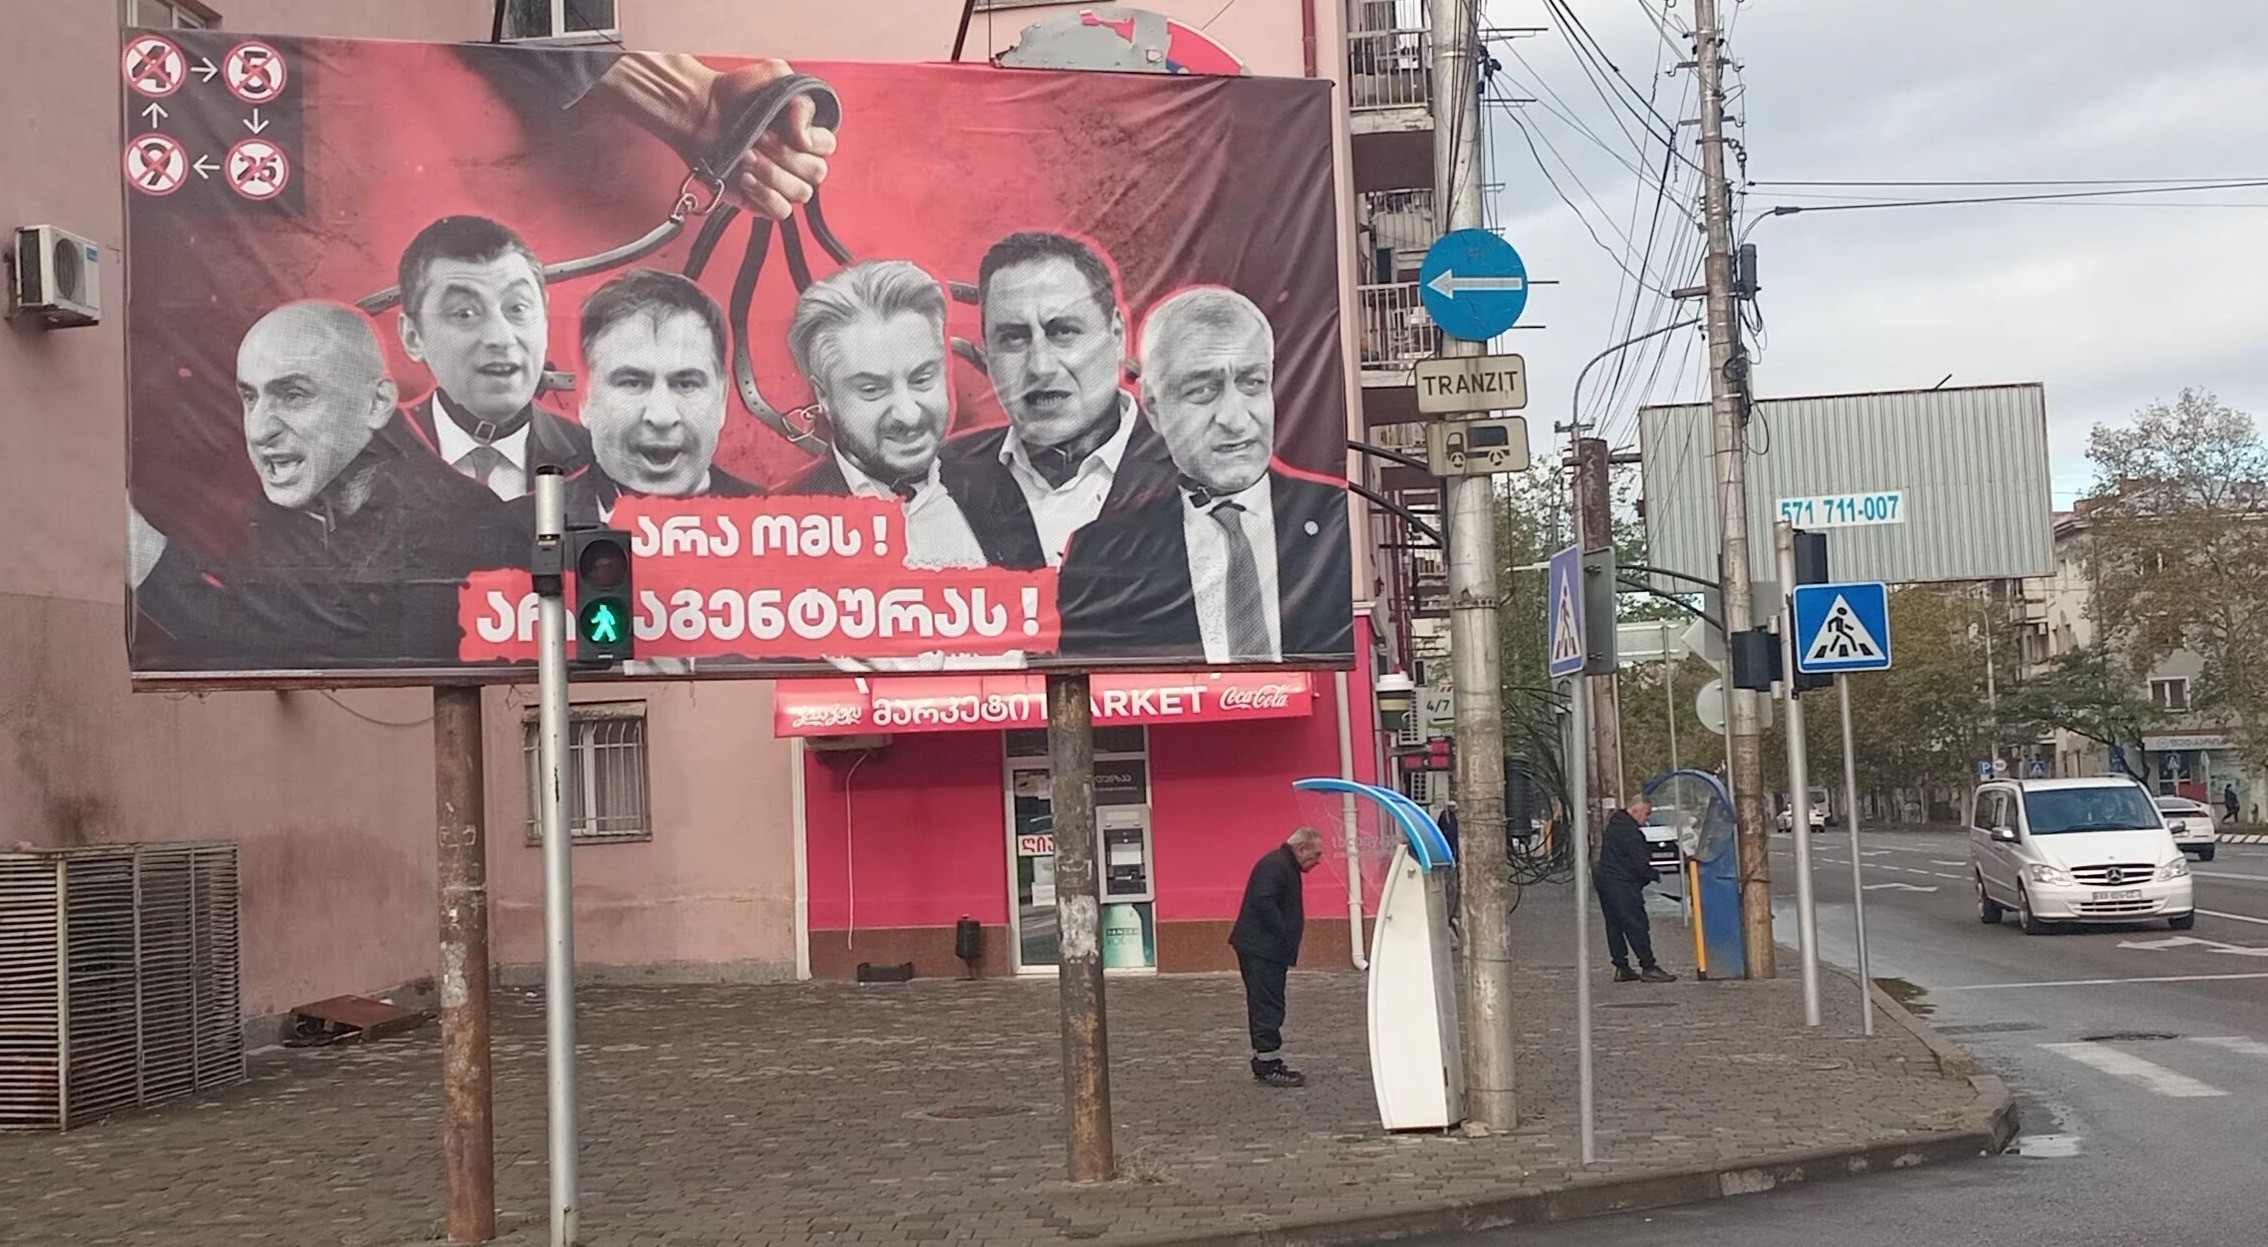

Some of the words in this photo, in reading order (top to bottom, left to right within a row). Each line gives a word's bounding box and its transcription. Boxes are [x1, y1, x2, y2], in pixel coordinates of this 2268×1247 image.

[240, 50, 272, 93] 5
[140, 142, 171, 186] 9
[236, 156, 277, 182] 25
[1422, 370, 1518, 396] TRANZIT
[1781, 500, 1814, 525] 571
[1823, 495, 1899, 524] 711-007
[631, 515, 740, 558] არა
[752, 514, 862, 558] ომს
[872, 515, 889, 557] !
[476, 590, 577, 643] არ
[633, 587, 1008, 641] აგენტურას
[1021, 587, 1040, 637] !
[872, 692, 1030, 726] მარკეტი
